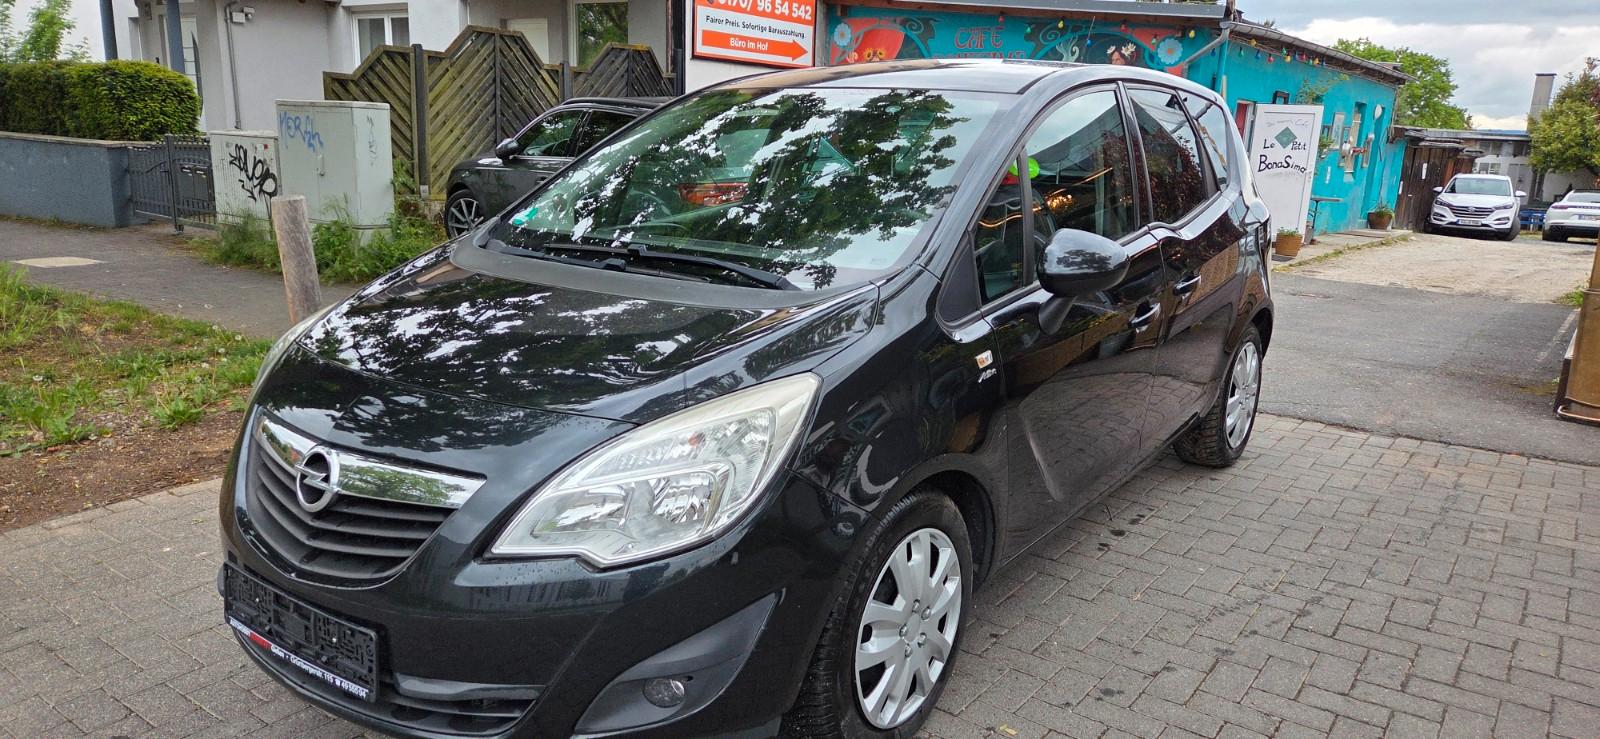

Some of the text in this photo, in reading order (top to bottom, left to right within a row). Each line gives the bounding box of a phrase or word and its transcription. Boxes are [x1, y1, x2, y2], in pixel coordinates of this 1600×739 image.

[757, 0, 772, 13] 96
[774, 0, 789, 16] 54
[791, 3, 812, 20] 542
[705, 15, 724, 25] Fairer
[725, 19, 741, 28] Preis.
[742, 22, 767, 33] Sofortige
[730, 37, 769, 51] Büro im Hof
[1263, 138, 1276, 149] Le
